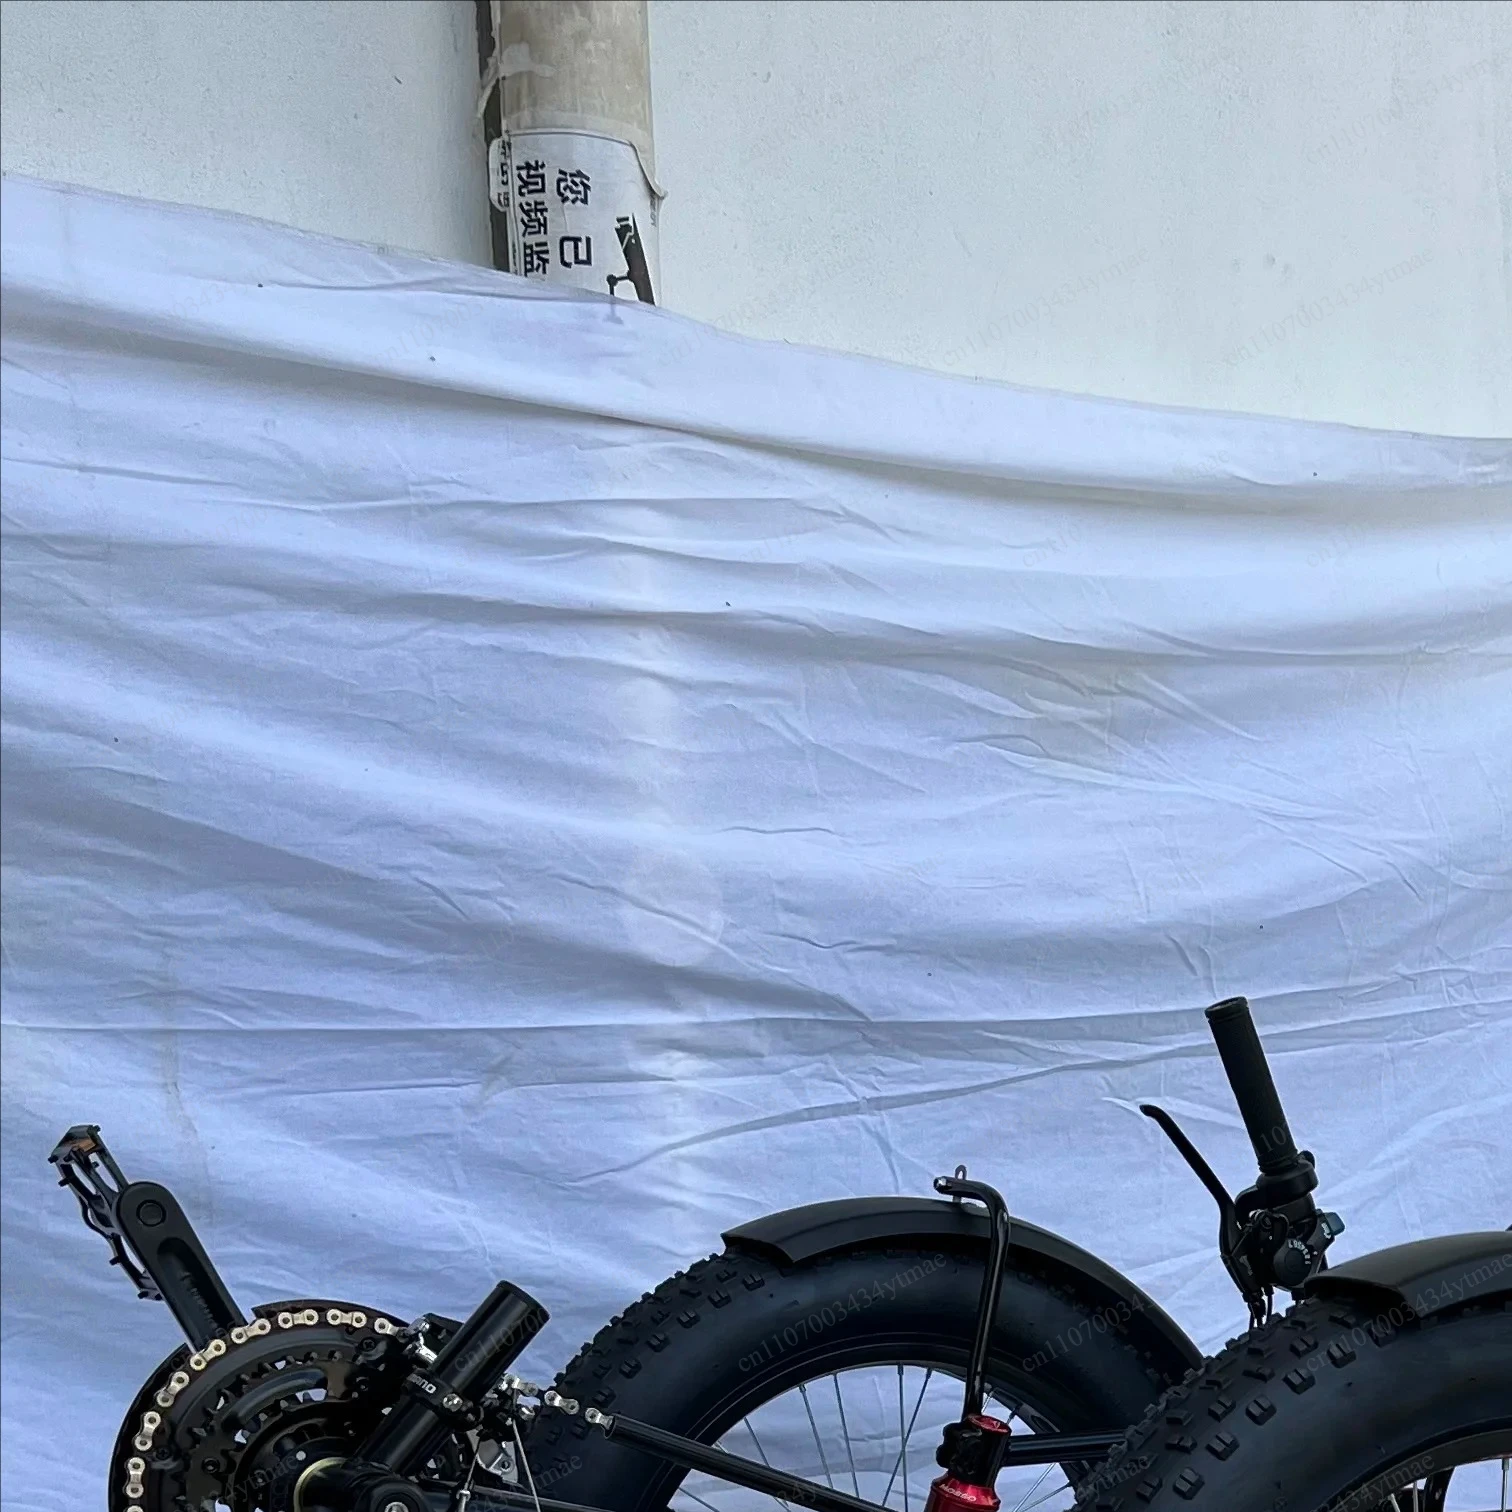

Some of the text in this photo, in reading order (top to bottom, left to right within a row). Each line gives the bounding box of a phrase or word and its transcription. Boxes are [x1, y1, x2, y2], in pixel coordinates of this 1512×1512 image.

[516, 160, 550, 277] 视频监
[556, 168, 593, 269] 您已
